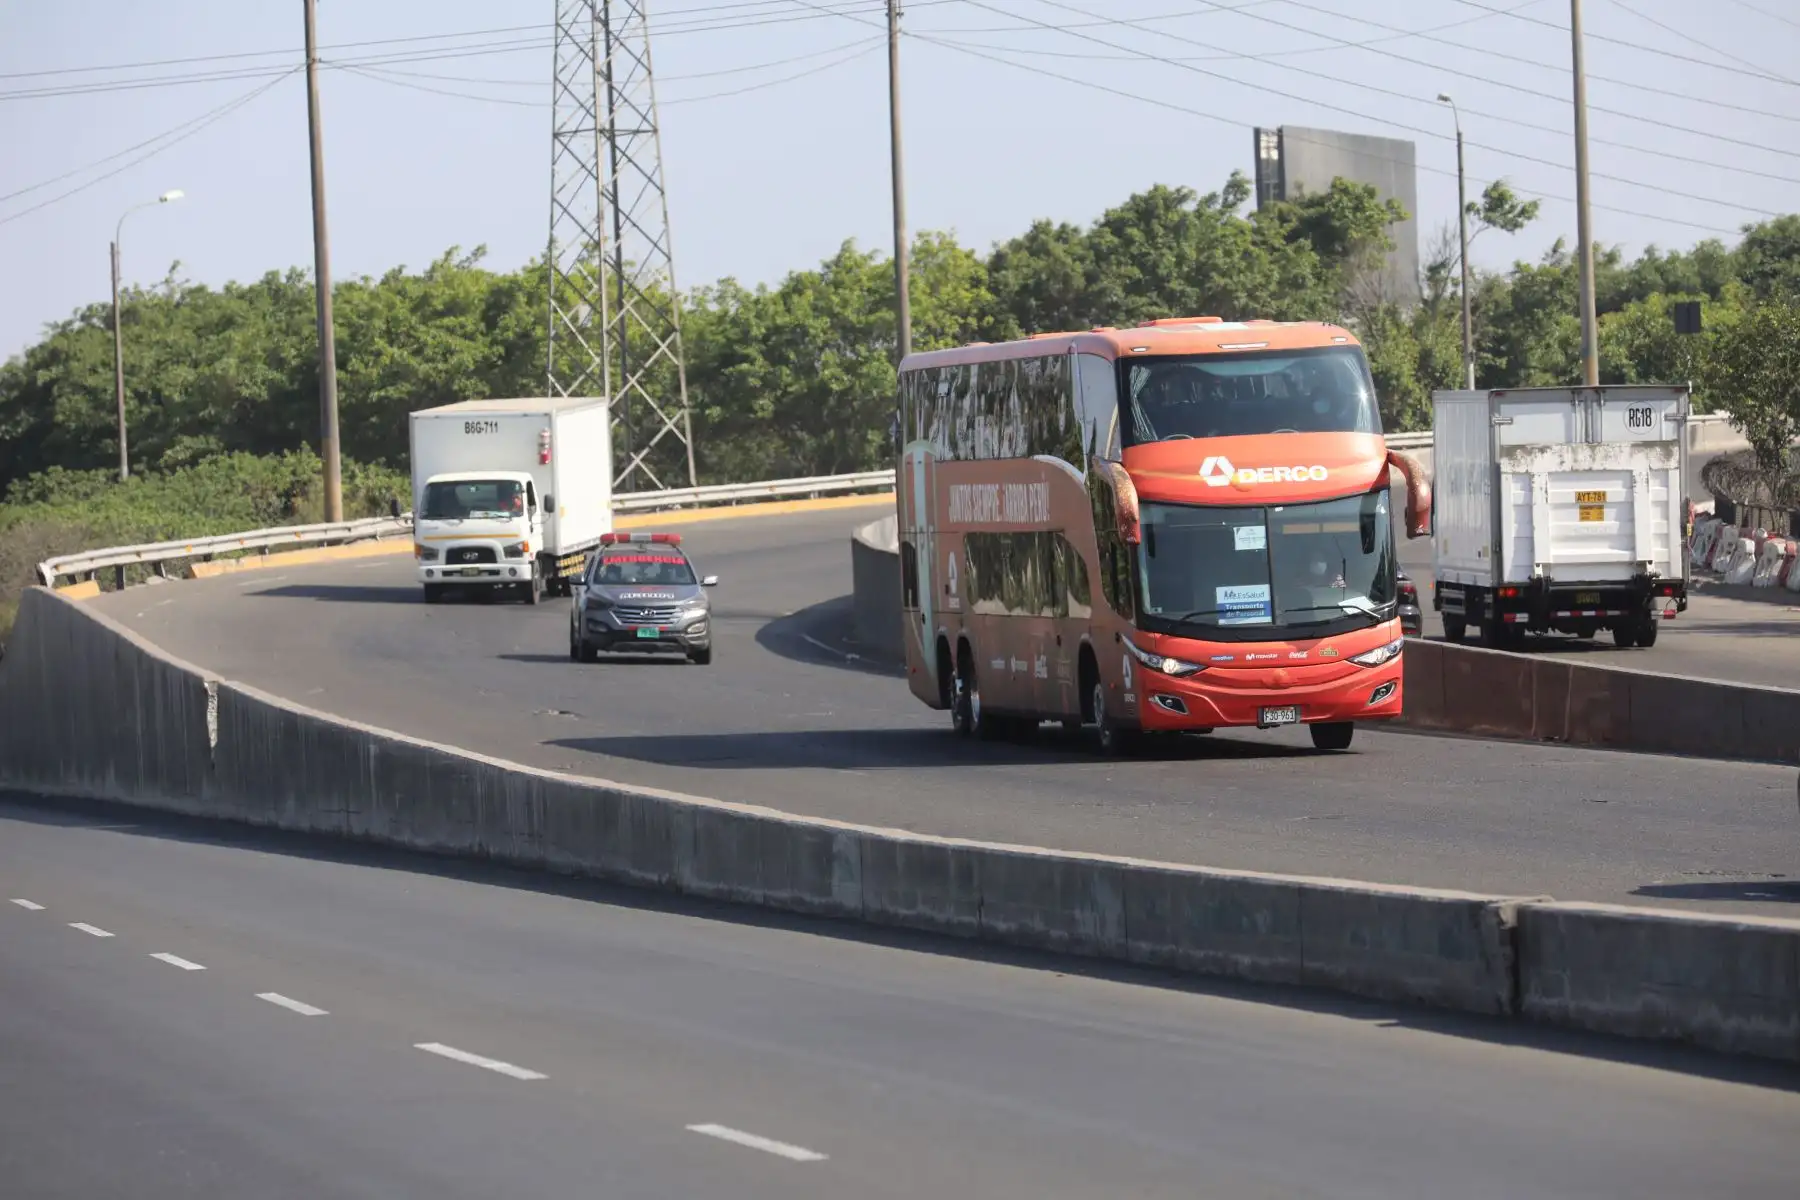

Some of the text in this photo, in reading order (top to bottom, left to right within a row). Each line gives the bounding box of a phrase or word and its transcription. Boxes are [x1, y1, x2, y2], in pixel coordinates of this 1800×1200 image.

[1629, 407, 1652, 427] RG18
[464, 421, 499, 434] B6G-711
[1237, 465, 1328, 484] DERCO
[1225, 602, 1264, 610] Transporte
